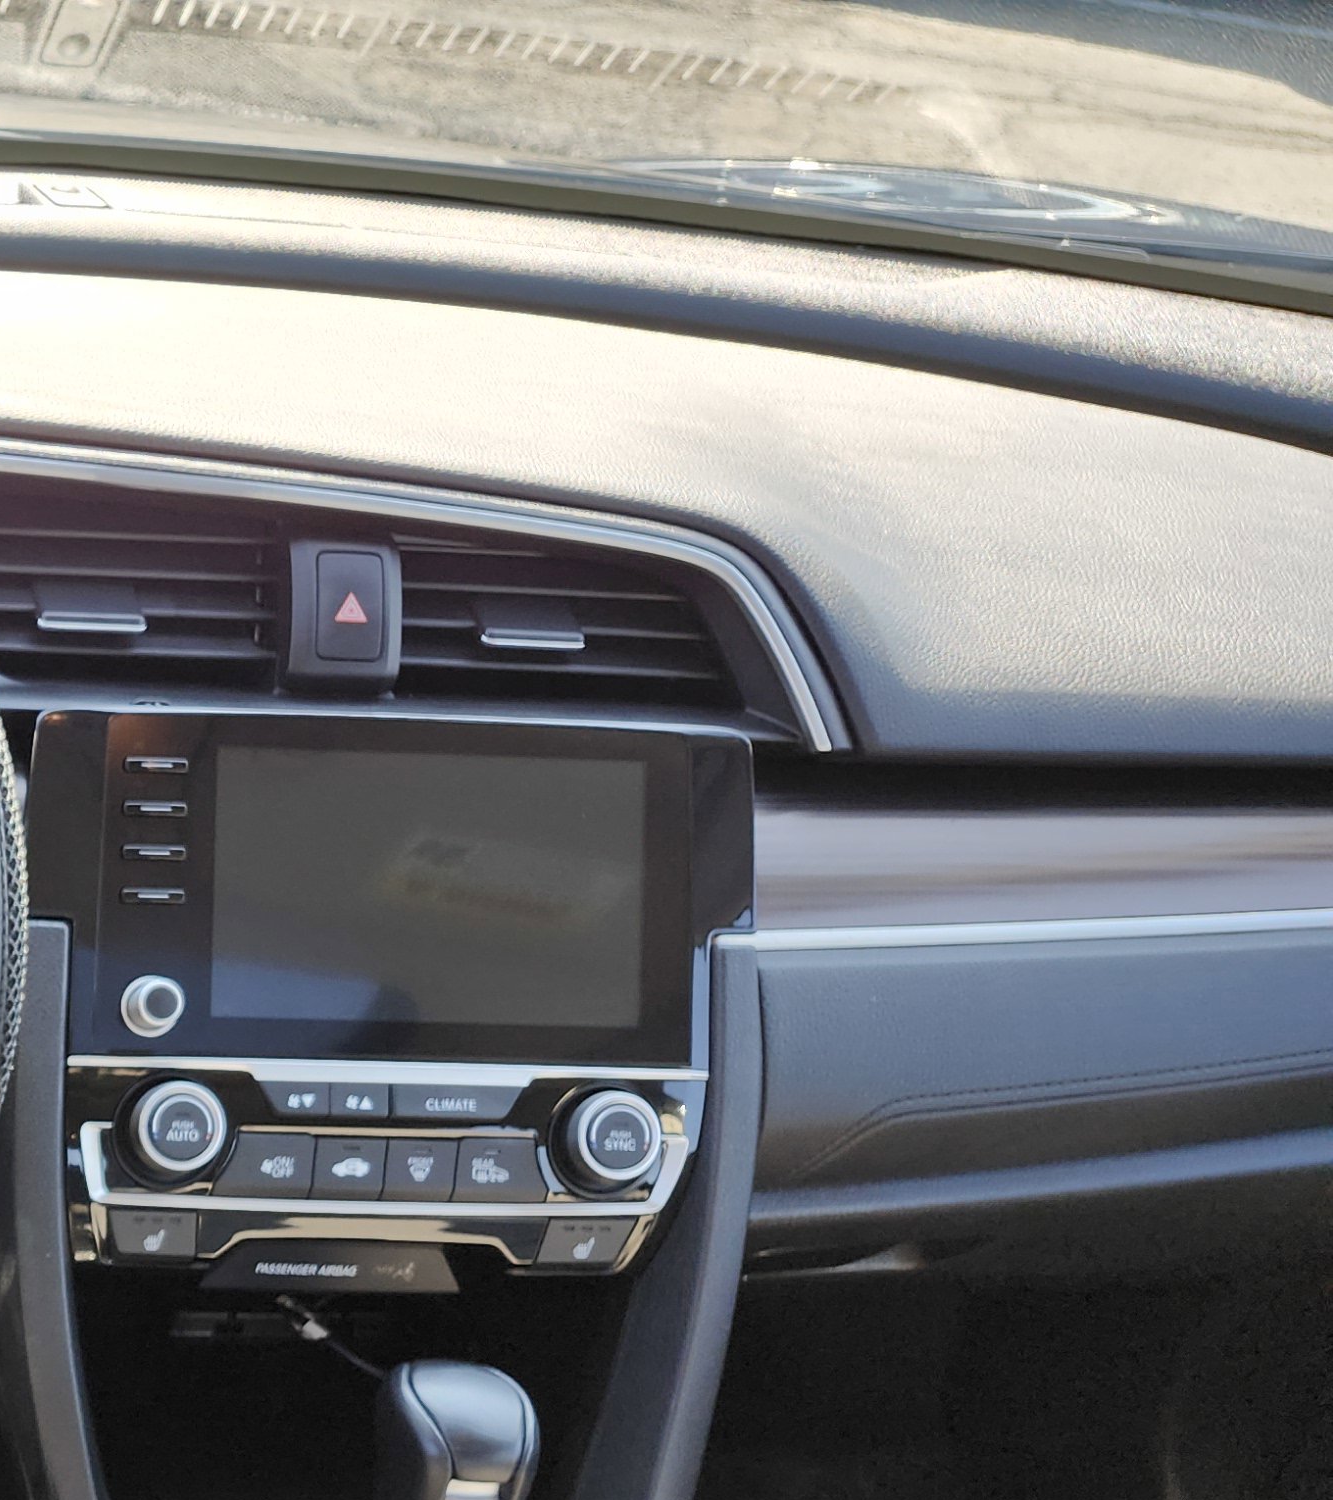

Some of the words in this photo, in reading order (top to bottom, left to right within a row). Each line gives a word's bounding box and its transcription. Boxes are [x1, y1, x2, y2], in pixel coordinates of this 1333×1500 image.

[425, 1098, 477, 1112] CLIMATE
[171, 1119, 195, 1129] PUSH
[165, 1130, 200, 1142] AUTO
[603, 1138, 637, 1152] SYNC
[255, 1262, 317, 1276] PASSENGER
[317, 1263, 359, 1277] AIRBAG
